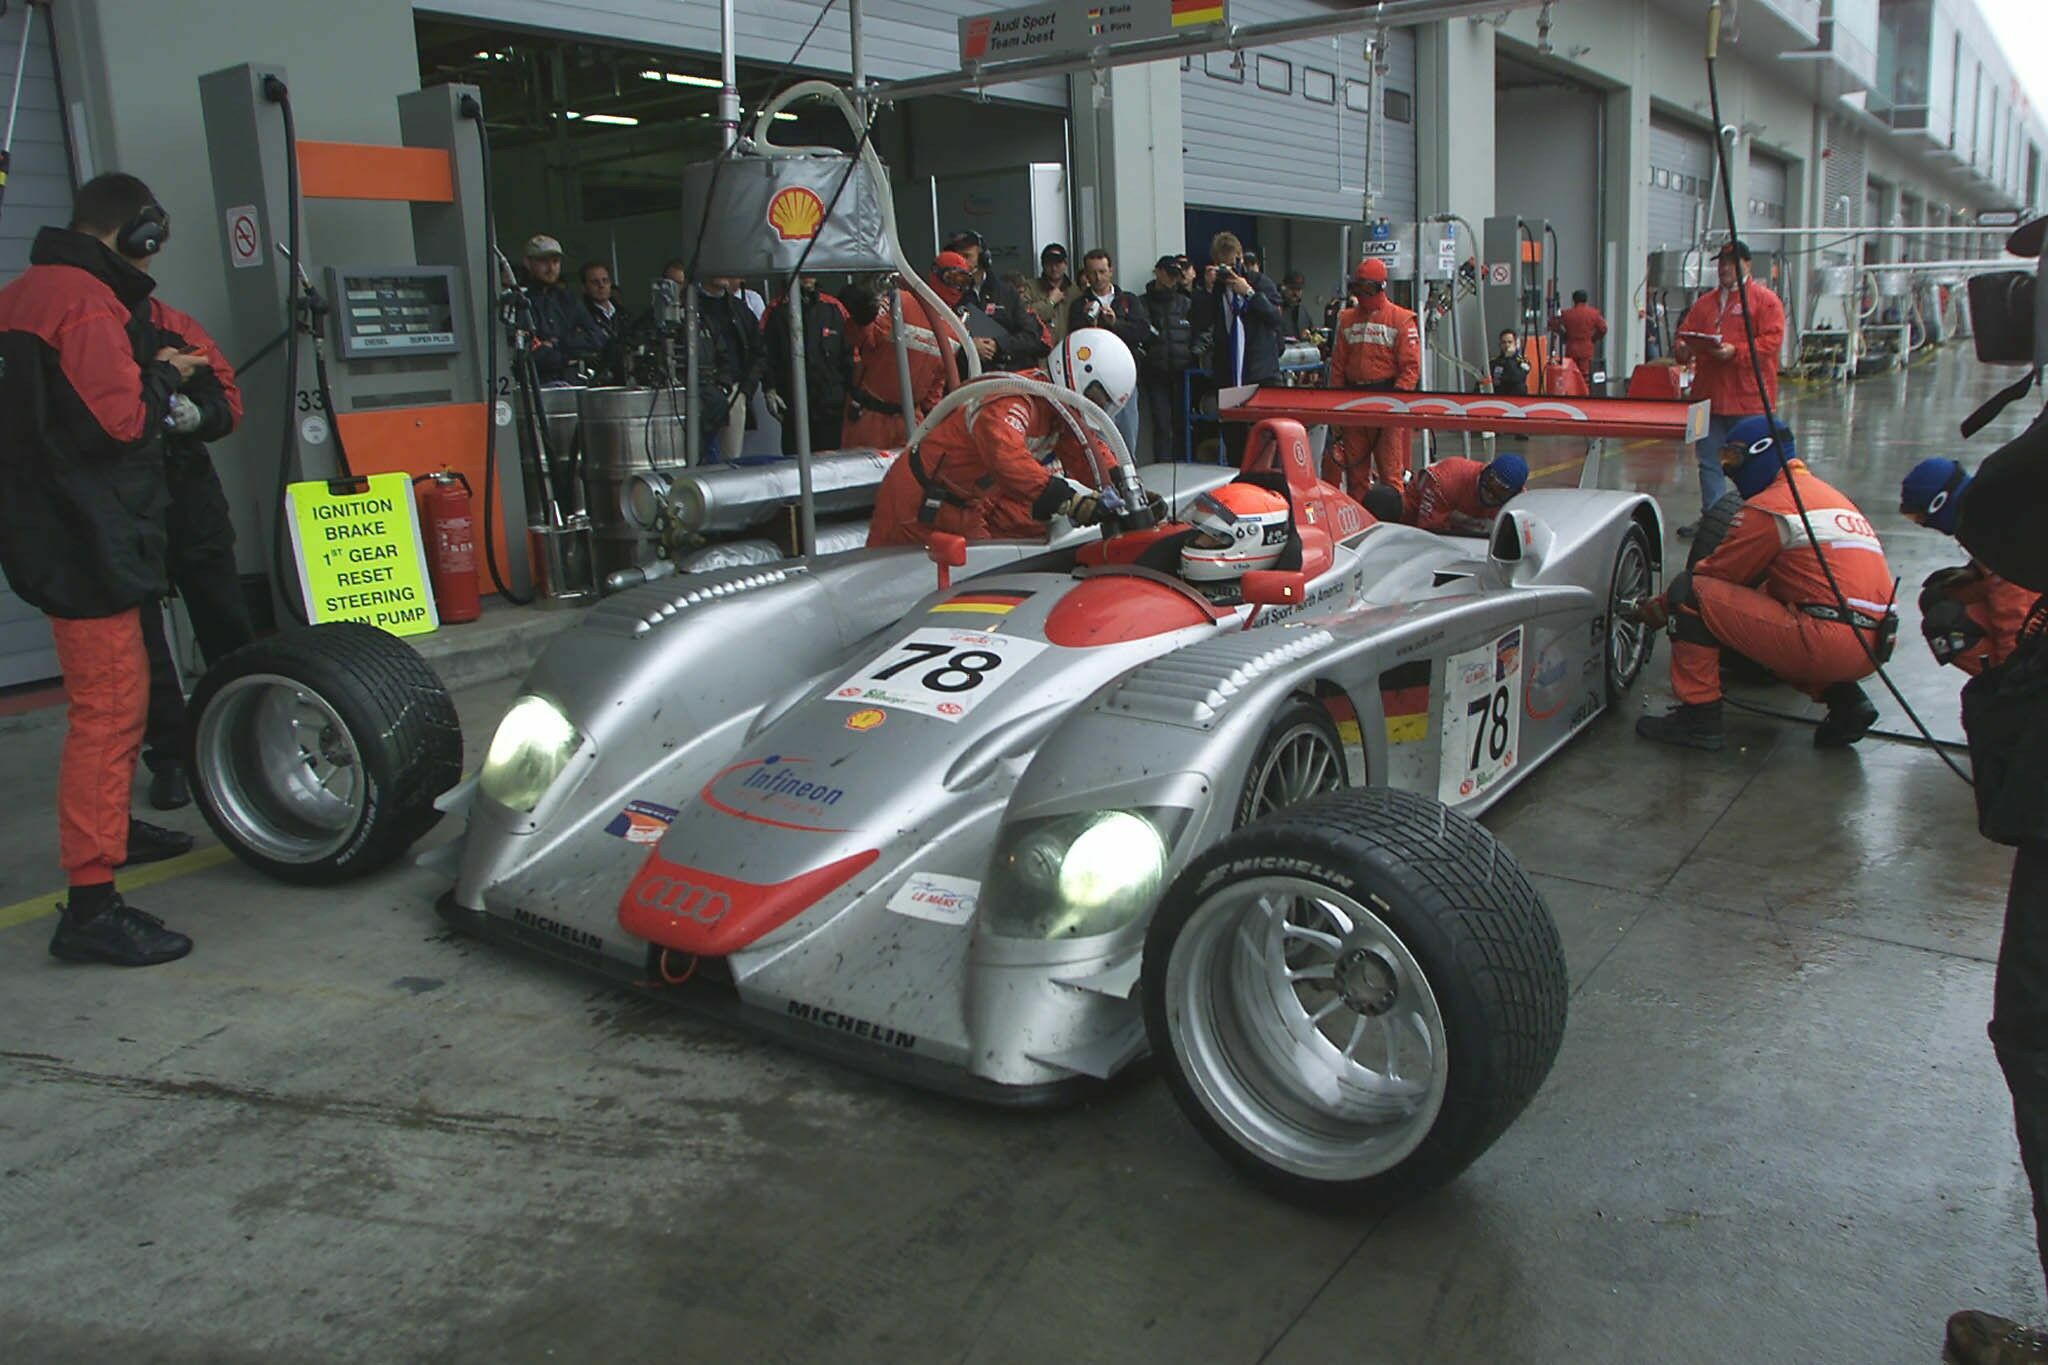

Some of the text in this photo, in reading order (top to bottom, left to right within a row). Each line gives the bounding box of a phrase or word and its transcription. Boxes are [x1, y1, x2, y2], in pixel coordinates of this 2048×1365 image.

[992, 12, 1056, 34] Audi Sport
[991, 29, 1055, 50] Team Joest
[433, 335, 450, 343] PLUS
[297, 390, 323, 411] 33
[313, 499, 393, 520] IGNITION
[325, 521, 386, 541] BRAKE
[349, 544, 398, 563] GEAR
[337, 567, 393, 587] RESET
[326, 587, 415, 612] STEERING
[1271, 604, 1294, 624] Sport
[1318, 582, 1345, 602] America
[377, 607, 426, 626] PUMP
[870, 643, 1002, 693] 78
[1468, 685, 1510, 772] 78
[743, 766, 843, 806] Infineon
[1233, 856, 1355, 889] MICHELIN
[911, 891, 958, 908] LE MANS
[513, 907, 604, 950] MICHELIN
[787, 999, 918, 1049] MICHELIN
